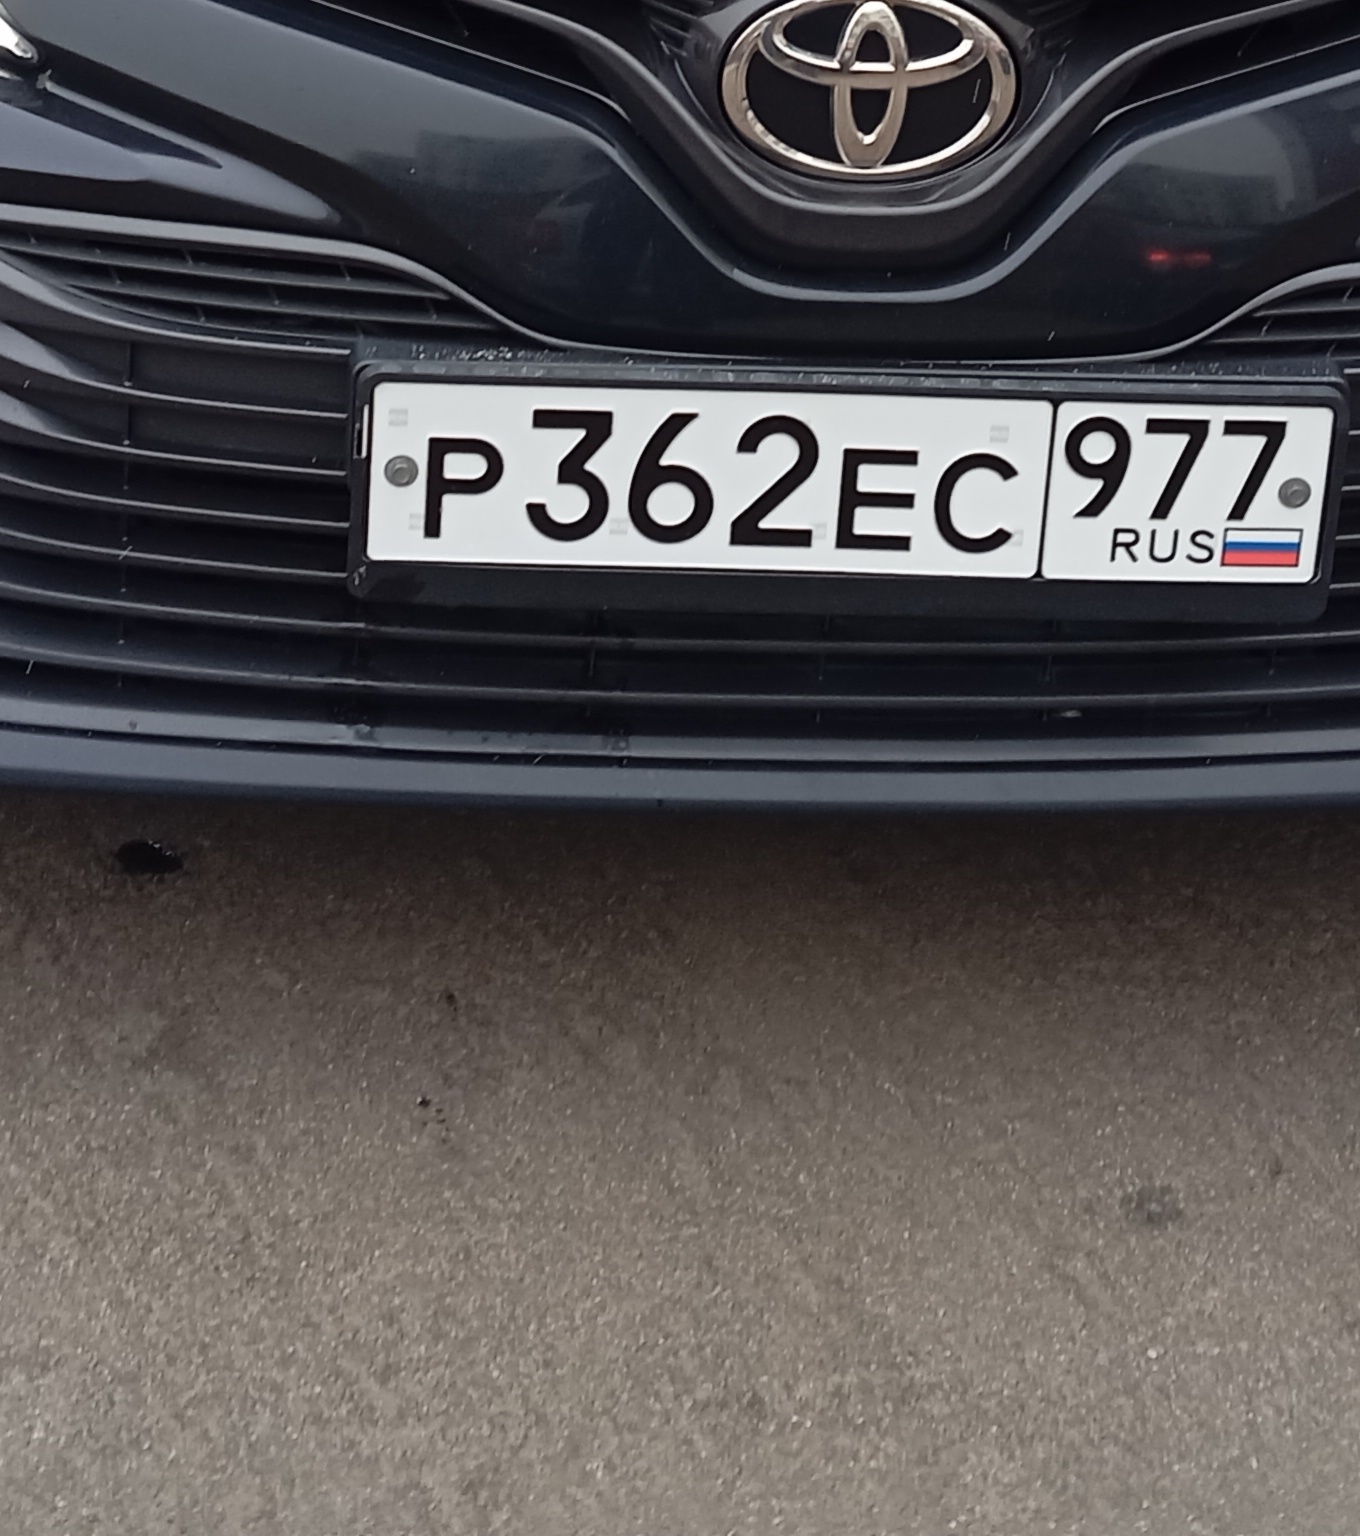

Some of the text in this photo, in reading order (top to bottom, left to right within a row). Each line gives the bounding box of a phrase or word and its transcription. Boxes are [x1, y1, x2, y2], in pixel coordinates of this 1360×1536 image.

[424, 409, 1288, 554] Р362ЕС 977
[1110, 527, 1215, 564] RUS
